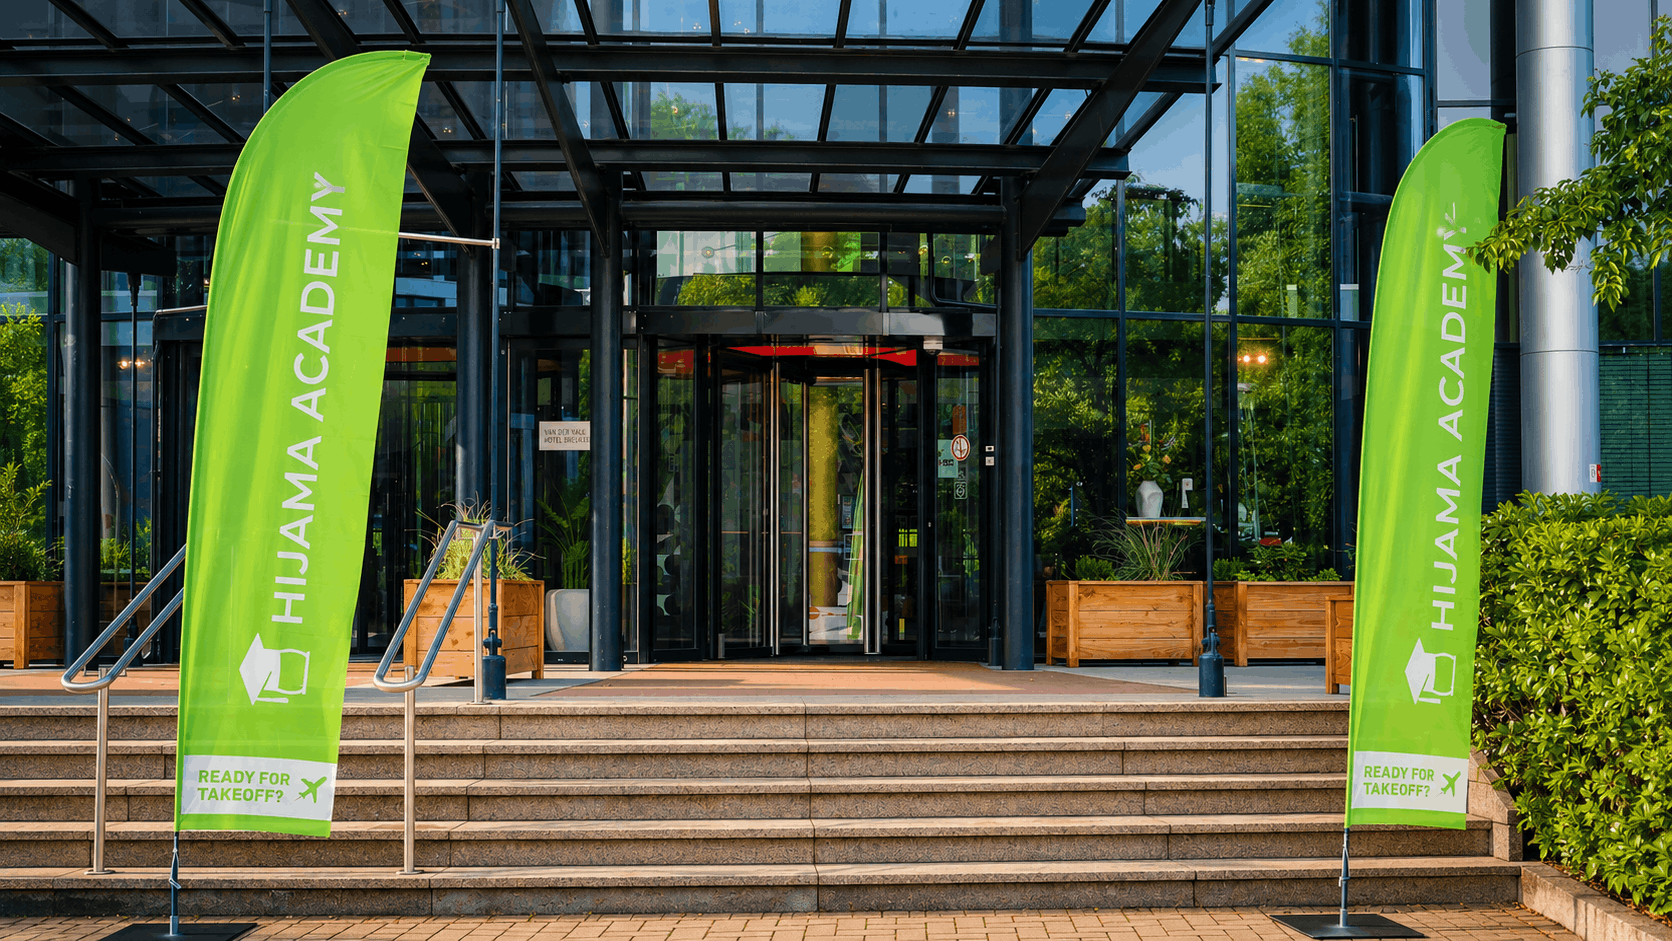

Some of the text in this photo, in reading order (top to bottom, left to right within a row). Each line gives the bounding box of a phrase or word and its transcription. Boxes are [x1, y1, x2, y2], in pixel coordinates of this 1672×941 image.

[271, 171, 347, 625] HIJAMA ACADEMY
[1431, 455, 1463, 632] HIJAMA
[198, 769, 291, 786] READY FOR
[1364, 765, 1435, 782] READY FOR
[197, 787, 284, 803] TAKEOFF?
[1363, 782, 1431, 797] TAKEOFF?
